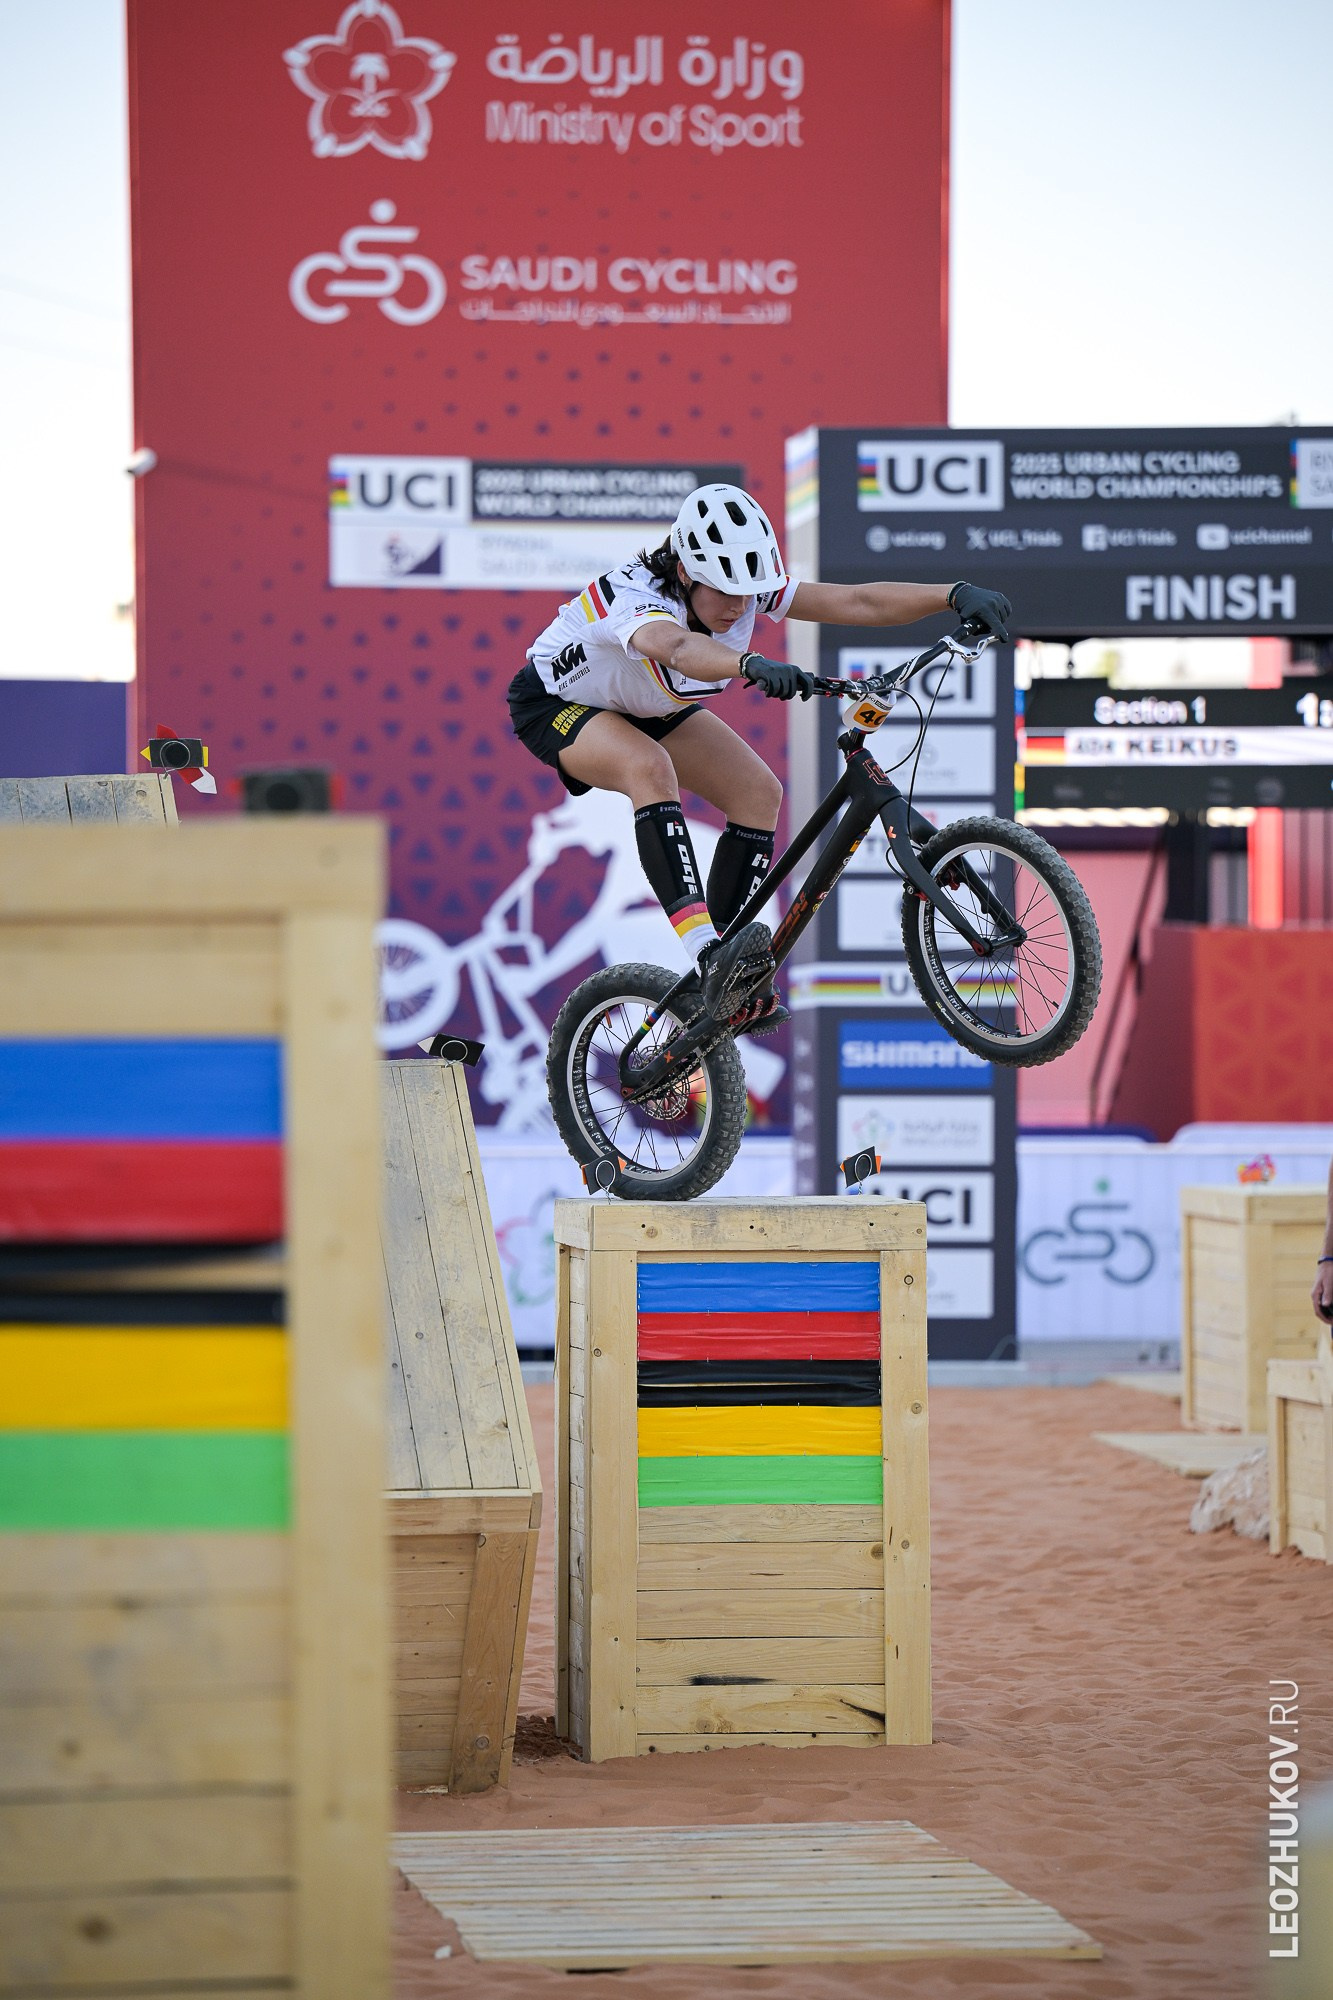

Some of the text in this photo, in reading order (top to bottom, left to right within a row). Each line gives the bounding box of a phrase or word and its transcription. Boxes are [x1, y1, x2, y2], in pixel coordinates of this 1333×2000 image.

[486, 34, 804, 100] وزارة الرياضة
[486, 102, 804, 155] Ministry of Sport
[460, 255, 797, 294] SAUDI CYCLING
[887, 457, 988, 496] UCI
[1011, 451, 1241, 475] 2025 URBAN CYCLING
[357, 471, 454, 508] UCI
[1010, 476, 1094, 499] WORLD
[1097, 474, 1283, 499] CHAMPIONSHIPS
[1125, 575, 1296, 621] FINISH
[551, 642, 588, 682] KTM
[1094, 696, 1206, 724] Section 1
[1126, 738, 1238, 756] KEIKUS
[873, 1188, 971, 1225] CI
